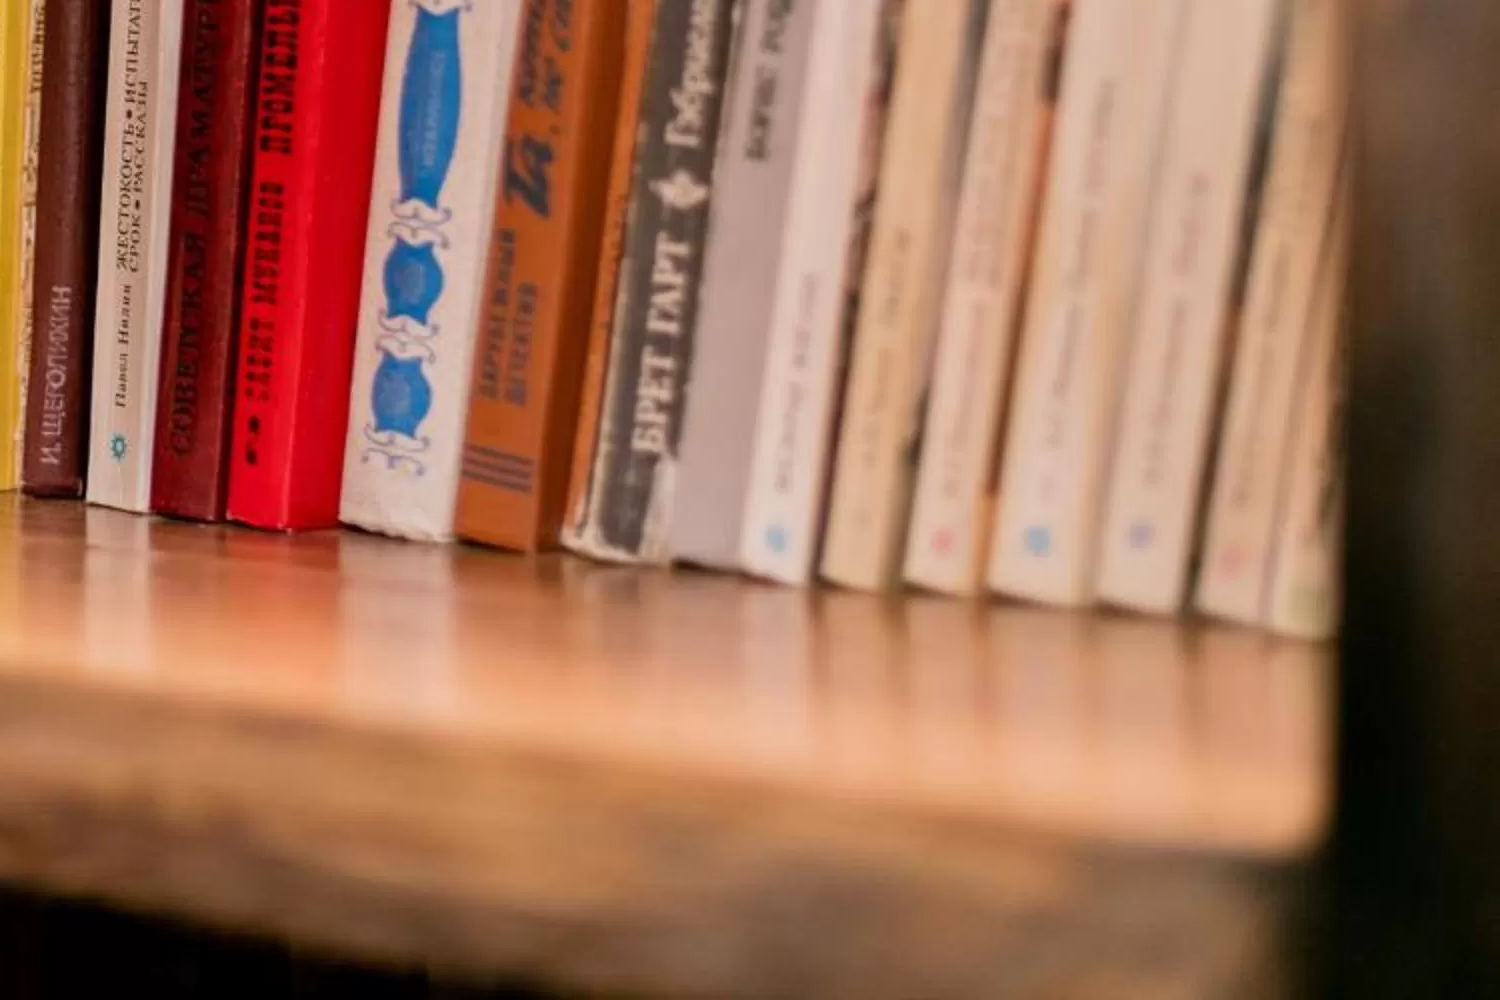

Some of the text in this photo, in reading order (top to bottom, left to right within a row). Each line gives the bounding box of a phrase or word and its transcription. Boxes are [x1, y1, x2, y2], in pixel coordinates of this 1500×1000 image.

[116, 121, 135, 272] ЖЕСТОКОСТЬ
[129, 81, 149, 273] СРОК РАССКАЗЫ
[118, 283, 133, 344] Нилин
[171, 233, 206, 456] СОВЕТСКАЯ
[647, 230, 690, 335] ГАРТ
[41, 285, 72, 437] ЩЕГОЛИХИН
[115, 353, 129, 408] Павел
[631, 346, 678, 453] БРЕТ
